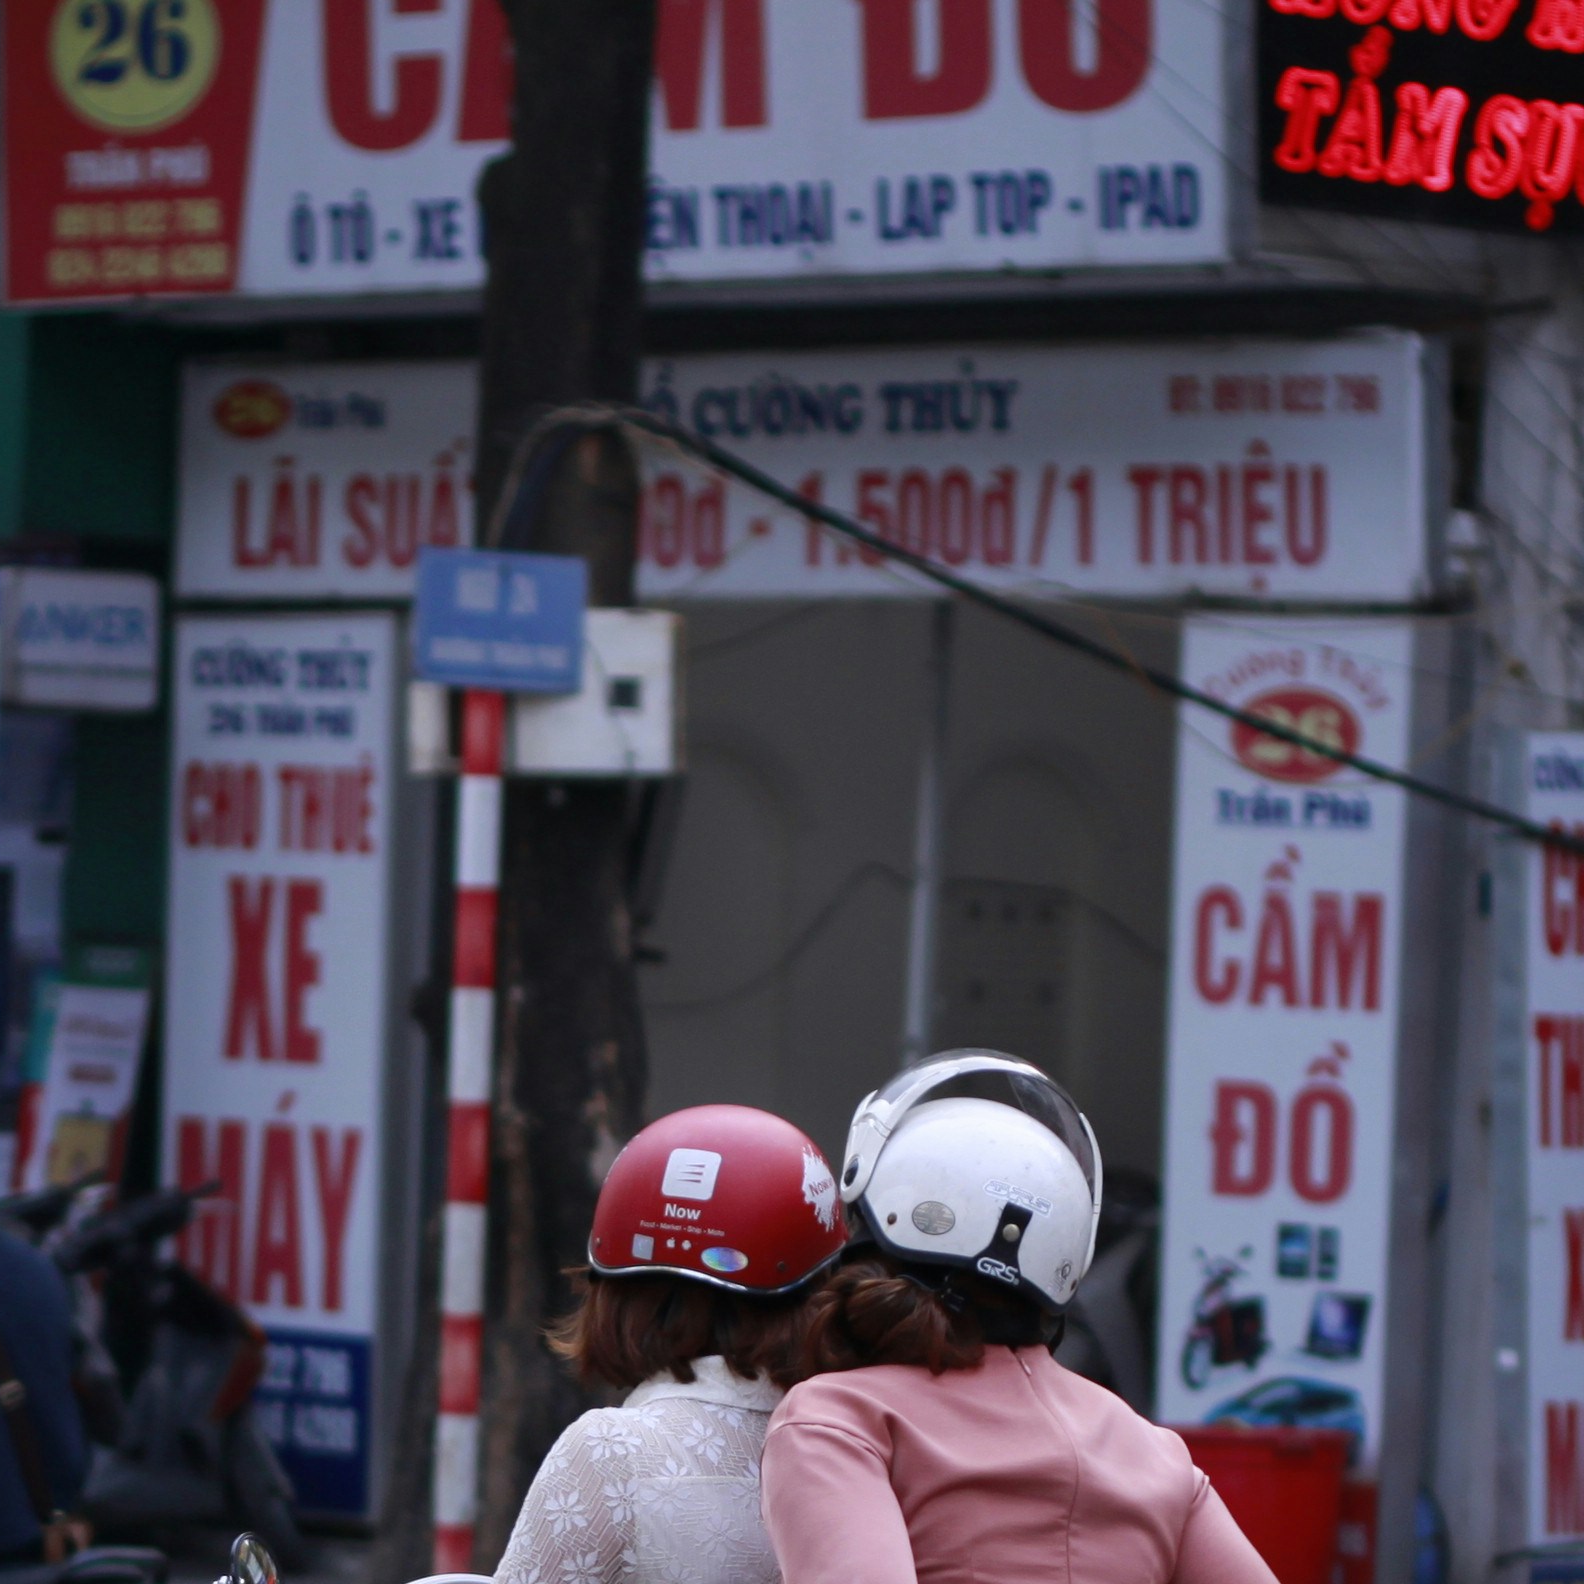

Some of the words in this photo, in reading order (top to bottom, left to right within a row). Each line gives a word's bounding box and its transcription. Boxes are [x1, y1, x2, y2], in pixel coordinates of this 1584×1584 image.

[77, 0, 192, 84] 26
[414, 199, 462, 260] XE
[712, 180, 834, 262] THOẠI
[876, 174, 957, 241] LAP
[969, 168, 1054, 236] TOP
[1098, 162, 1201, 231] IPAD
[342, 434, 480, 568] SUẤ
[1127, 436, 1329, 592] TRIỆU
[224, 876, 324, 1064] XE
[1192, 843, 1385, 1013] CẦM
[176, 1090, 363, 1312] MÁY
[1209, 1040, 1355, 1204] ĐỒ
[664, 1202, 702, 1221] Now
[976, 1256, 1020, 1285] GRS
